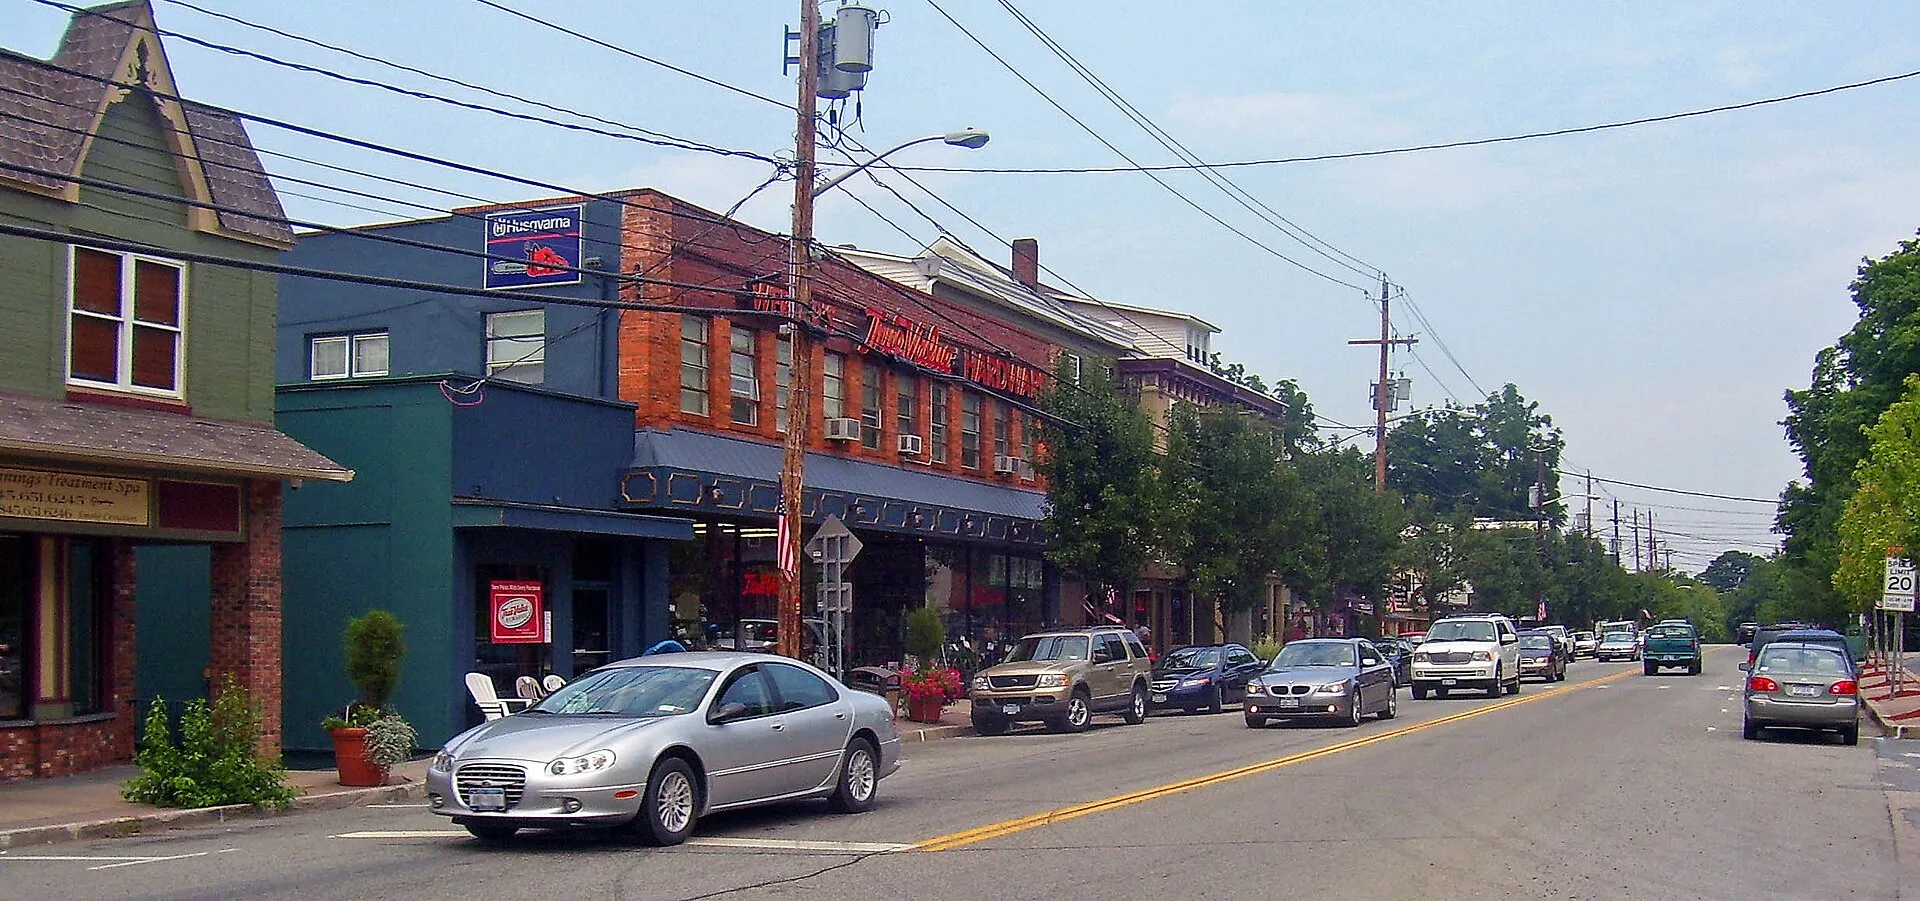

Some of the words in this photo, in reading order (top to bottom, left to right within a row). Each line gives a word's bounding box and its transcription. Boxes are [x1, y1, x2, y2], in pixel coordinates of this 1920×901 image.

[506, 218, 570, 233] Husqvarna
[46, 474, 112, 491] Treatment
[115, 480, 139, 496] Spa
[1887, 577, 1912, 591] 20
